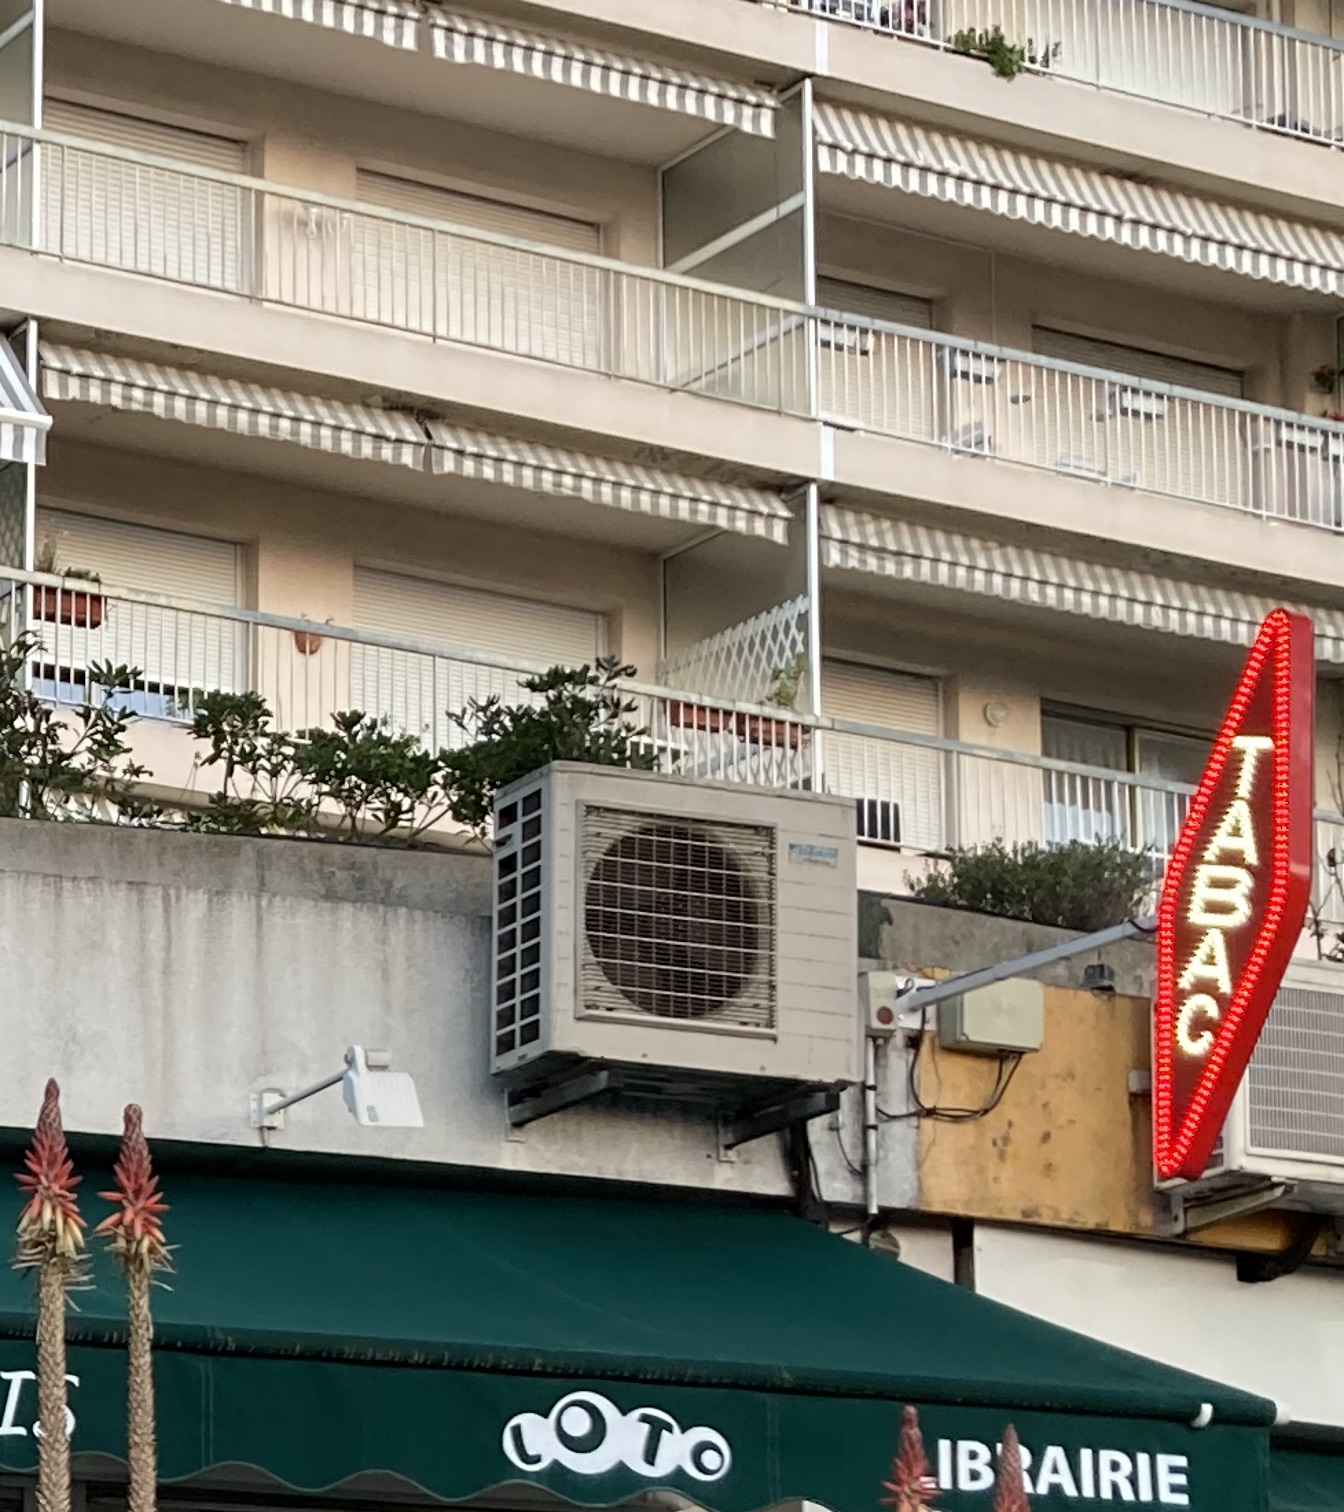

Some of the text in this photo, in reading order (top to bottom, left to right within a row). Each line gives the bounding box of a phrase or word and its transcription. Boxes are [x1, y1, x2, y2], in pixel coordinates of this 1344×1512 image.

[1176, 735, 1276, 1057] TABAC
[510, 1398, 725, 1477] LOTO
[918, 1437, 1190, 1506] IBRAIRIE
